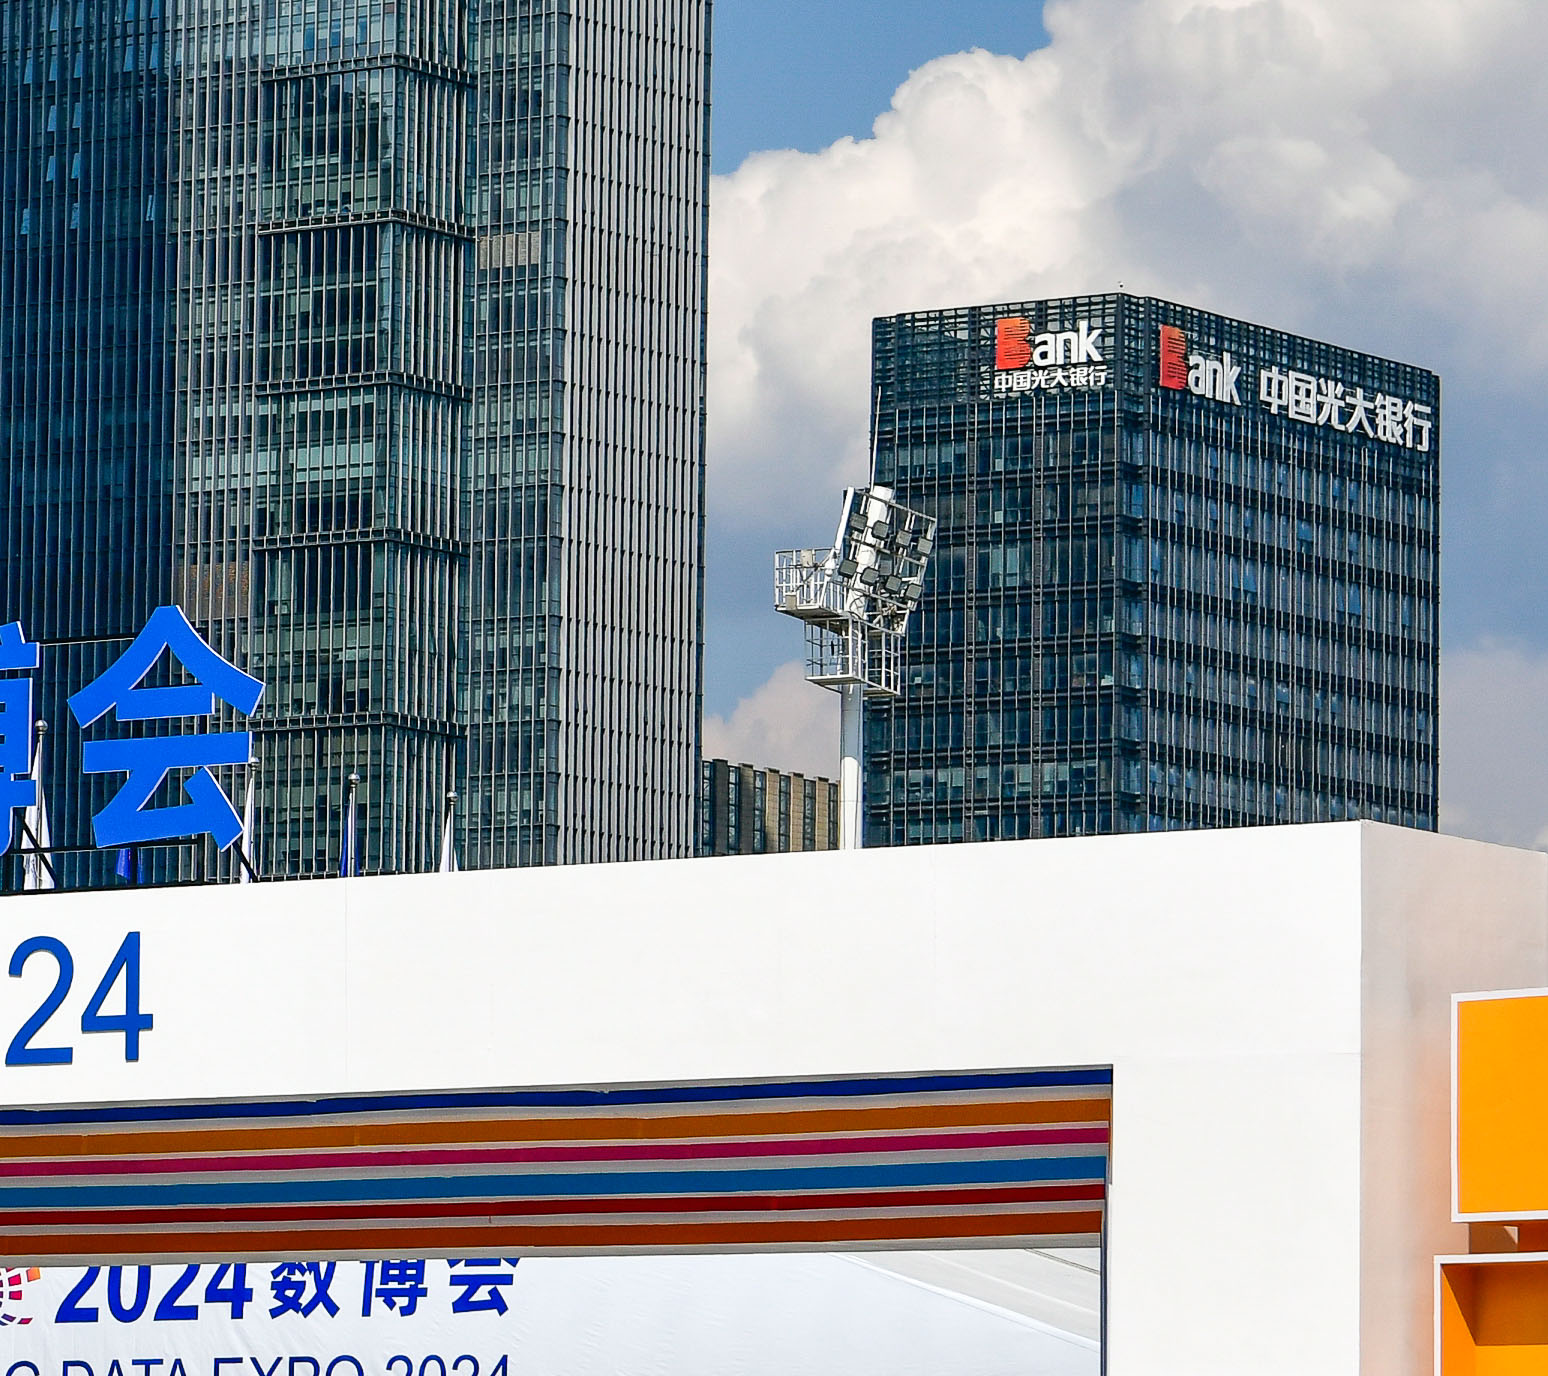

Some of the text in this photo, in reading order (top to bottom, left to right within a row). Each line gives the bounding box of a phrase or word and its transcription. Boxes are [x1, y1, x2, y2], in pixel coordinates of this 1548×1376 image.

[995, 317, 1104, 369] Bank
[994, 365, 1107, 393] 中国光大银行
[1159, 324, 1432, 452] Bank 中国光大银行
[55, 1257, 520, 1323] 2024 数博会
